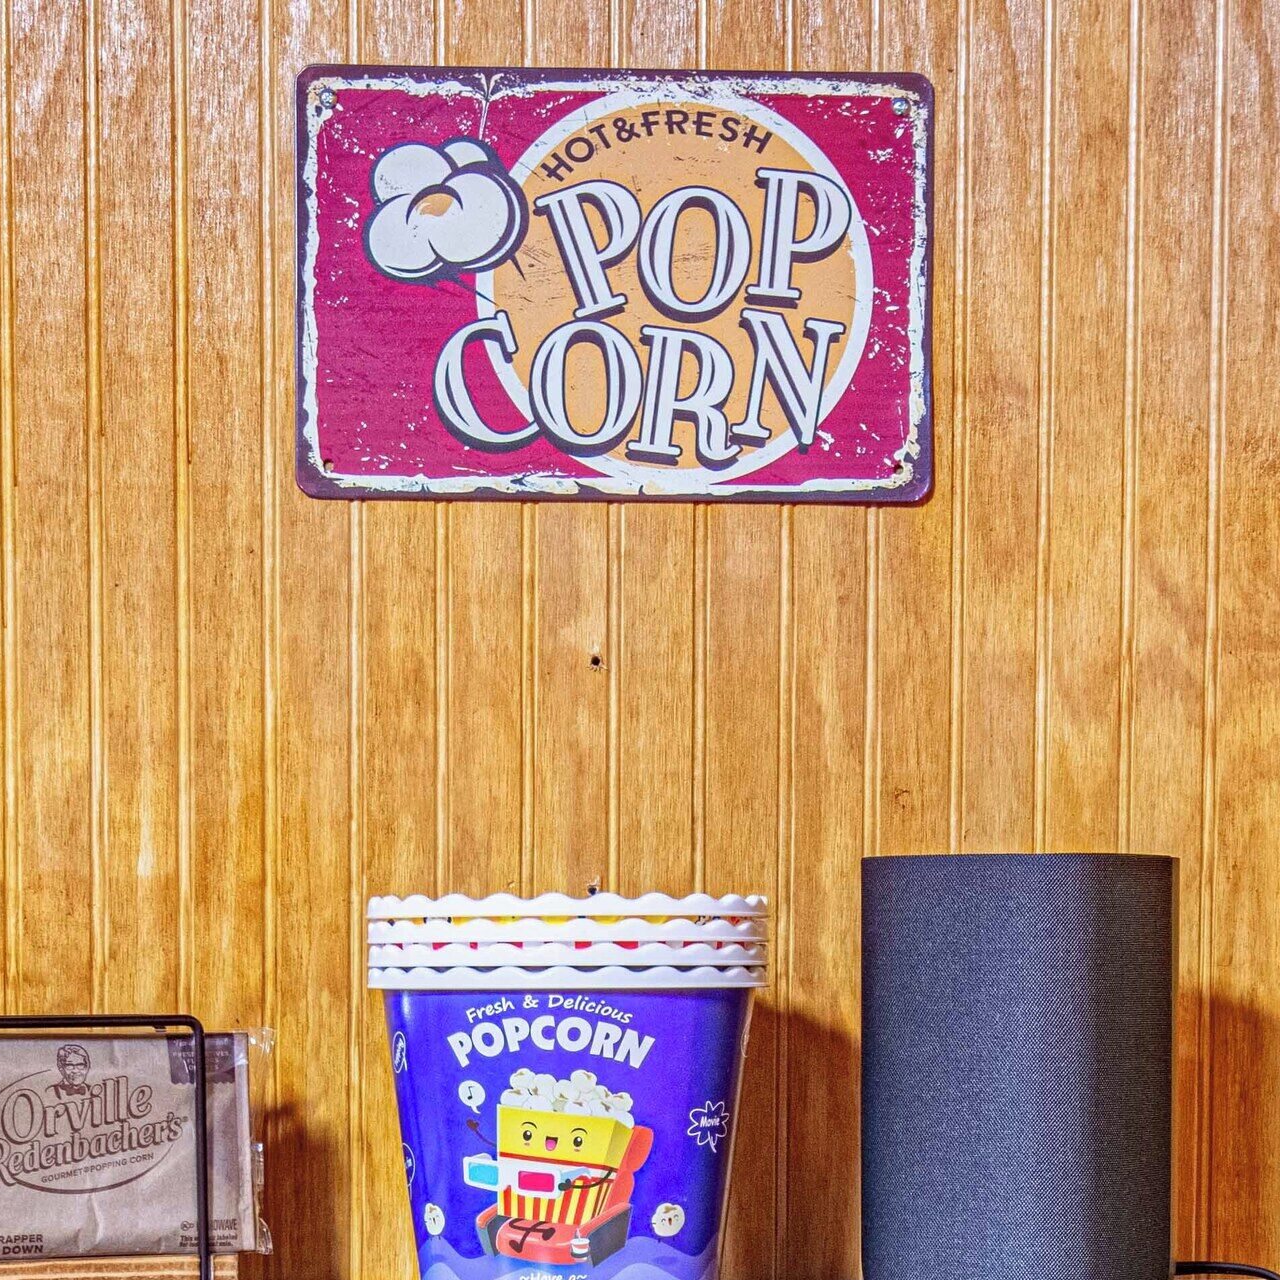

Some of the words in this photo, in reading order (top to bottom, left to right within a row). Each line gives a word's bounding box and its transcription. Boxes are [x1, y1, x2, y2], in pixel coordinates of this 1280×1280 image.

[540, 109, 774, 182] HOT&FRESH
[535, 167, 852, 322] POP
[433, 309, 845, 463] CORN
[465, 997, 515, 1023] Fresh
[522, 994, 539, 1009] &
[548, 994, 634, 1024] Delicious
[446, 1014, 656, 1070] POPCORN
[1, 1076, 153, 1144] Orville
[700, 1115, 720, 1127] Movie
[129, 1152, 154, 1165] CORN
[1, 1244, 44, 1255] DOWN
